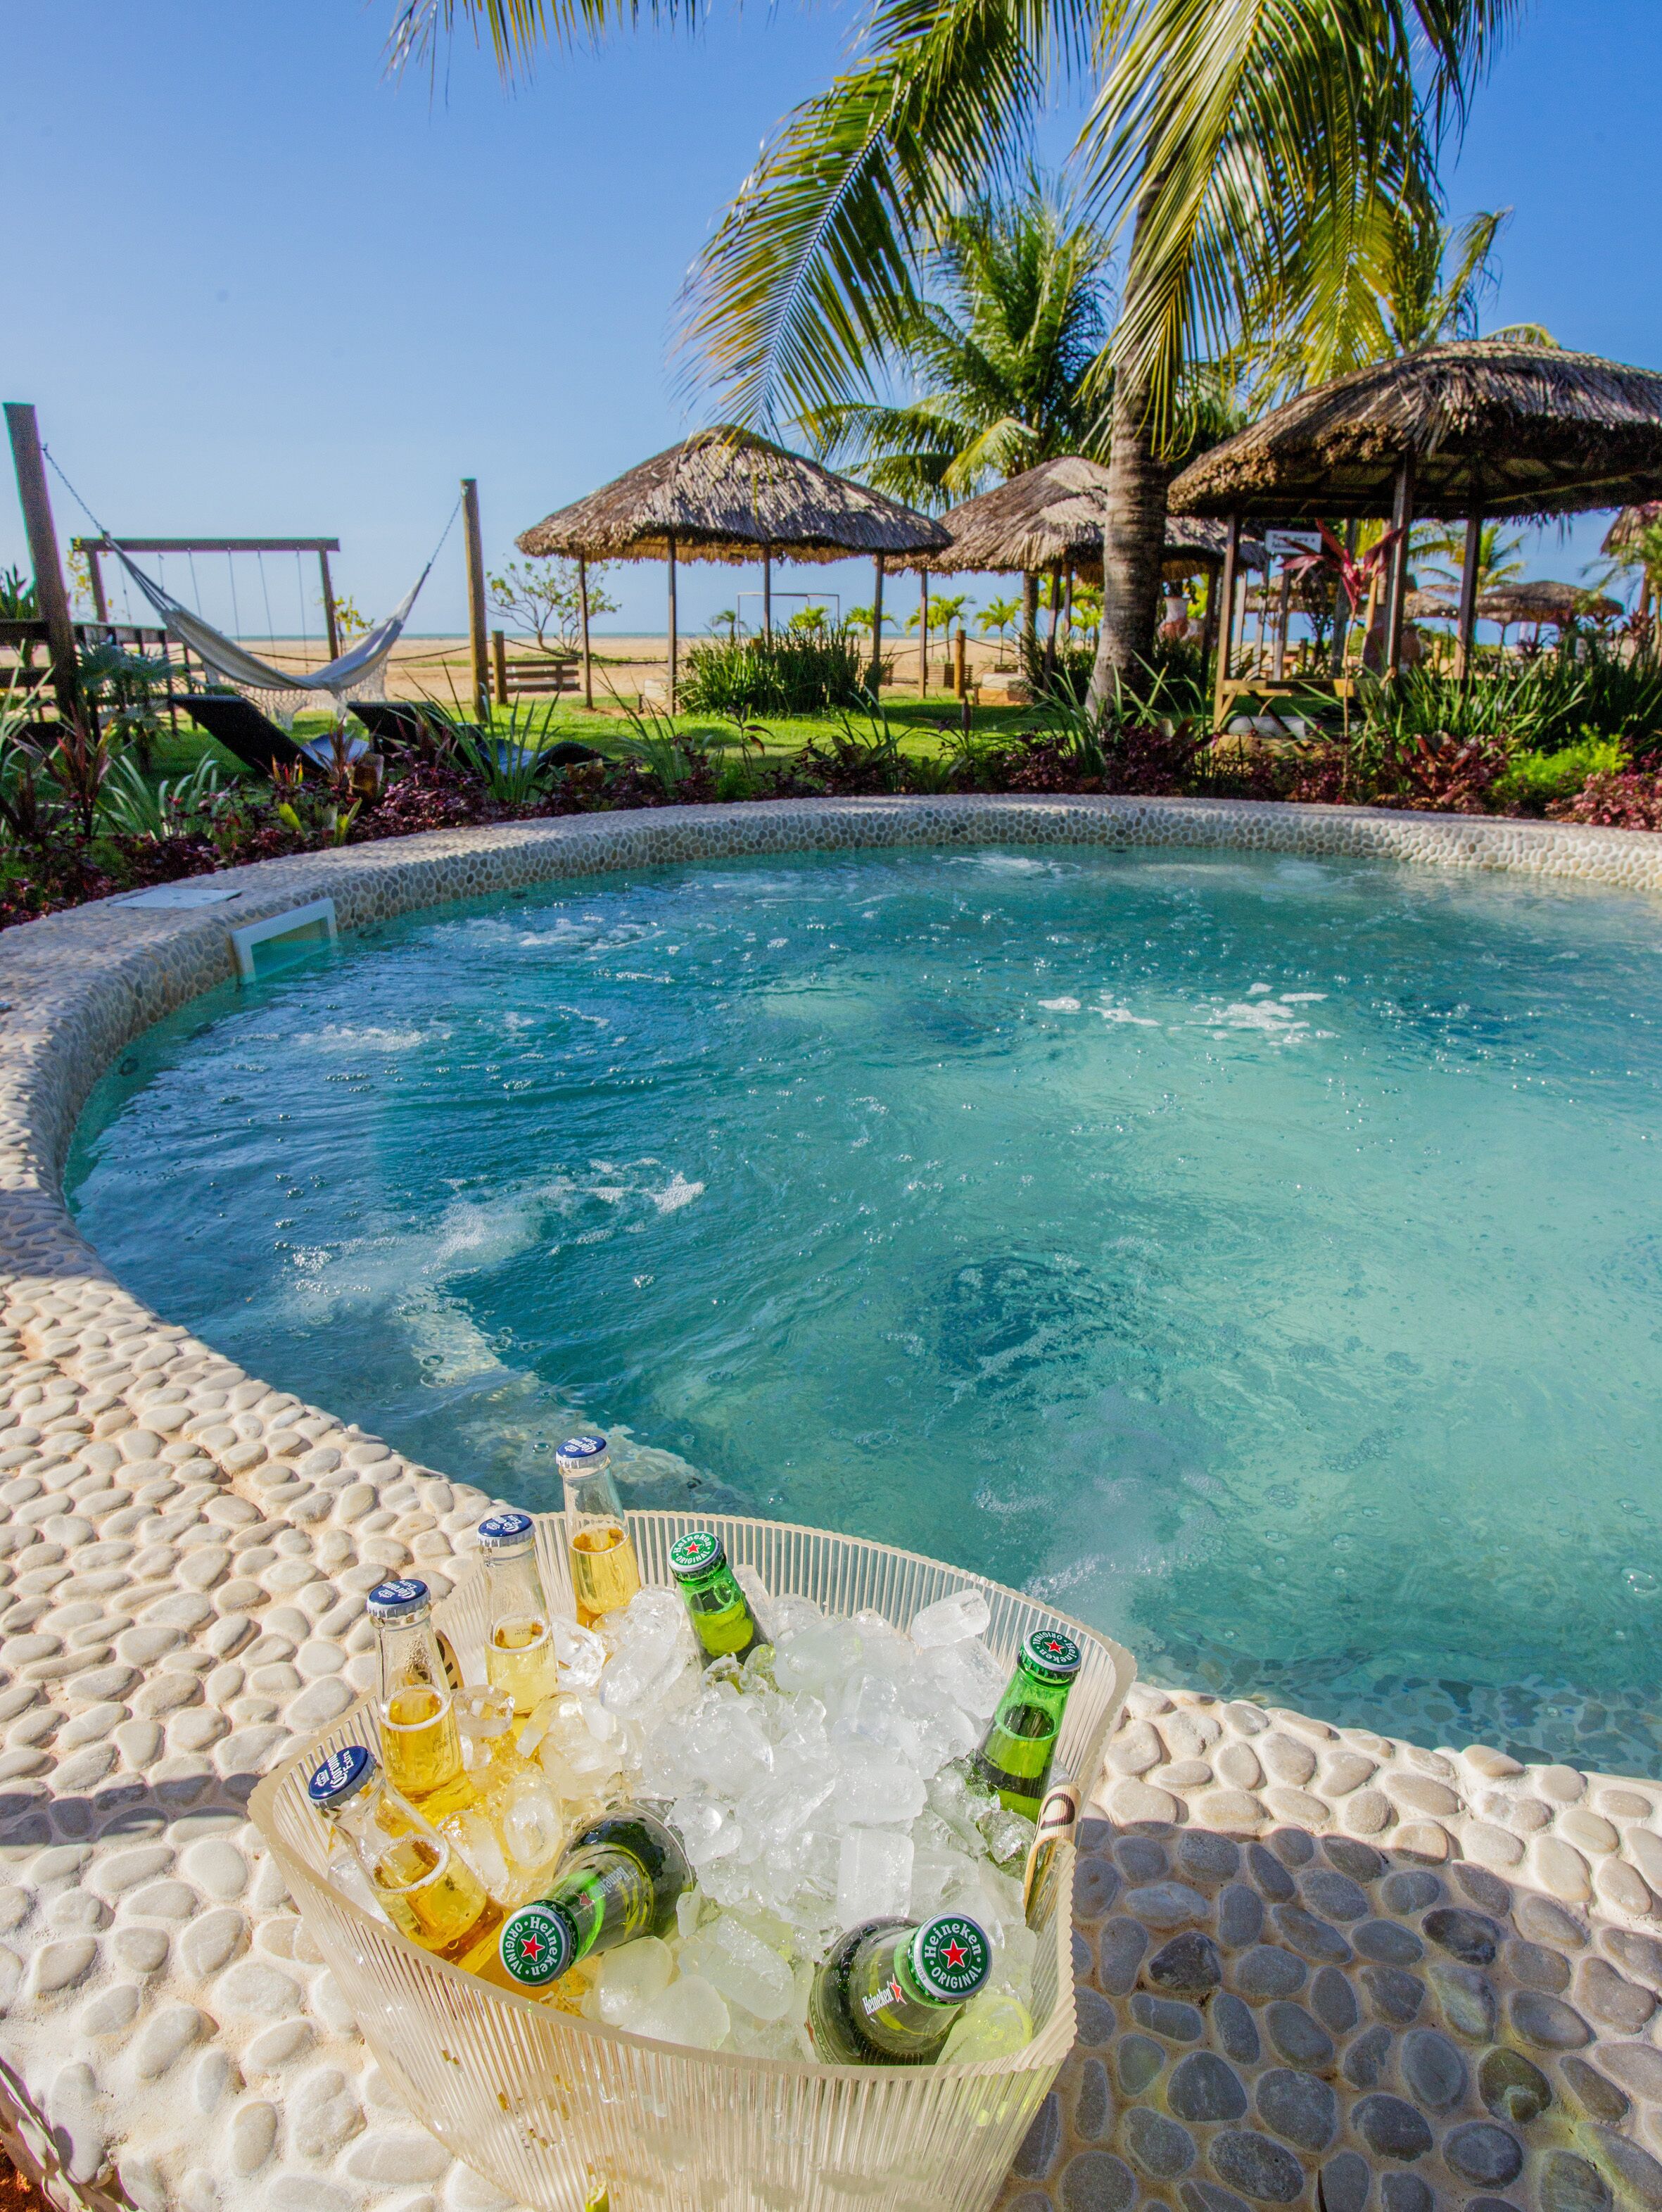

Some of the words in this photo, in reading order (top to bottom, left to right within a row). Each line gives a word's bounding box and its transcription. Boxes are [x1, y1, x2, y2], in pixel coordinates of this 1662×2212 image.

[568, 1439, 597, 1453] Corona
[673, 1534, 711, 1554] Heineken
[676, 1551, 710, 1565] ORIGINAL
[382, 1581, 416, 1599] Corona
[400, 1580, 417, 1591] Extra
[1033, 1632, 1062, 1645] ORIGINAL
[1039, 1643, 1077, 1664] Heineken
[327, 1753, 348, 1788] Corona
[343, 1750, 354, 1771] Extra
[505, 1922, 523, 1975] ORIGINAL
[530, 1916, 557, 1976] Heineken
[925, 1923, 982, 1958] Heineken
[931, 1966, 982, 1989] ORIGINAL
[862, 1987, 894, 2016] Heineken
